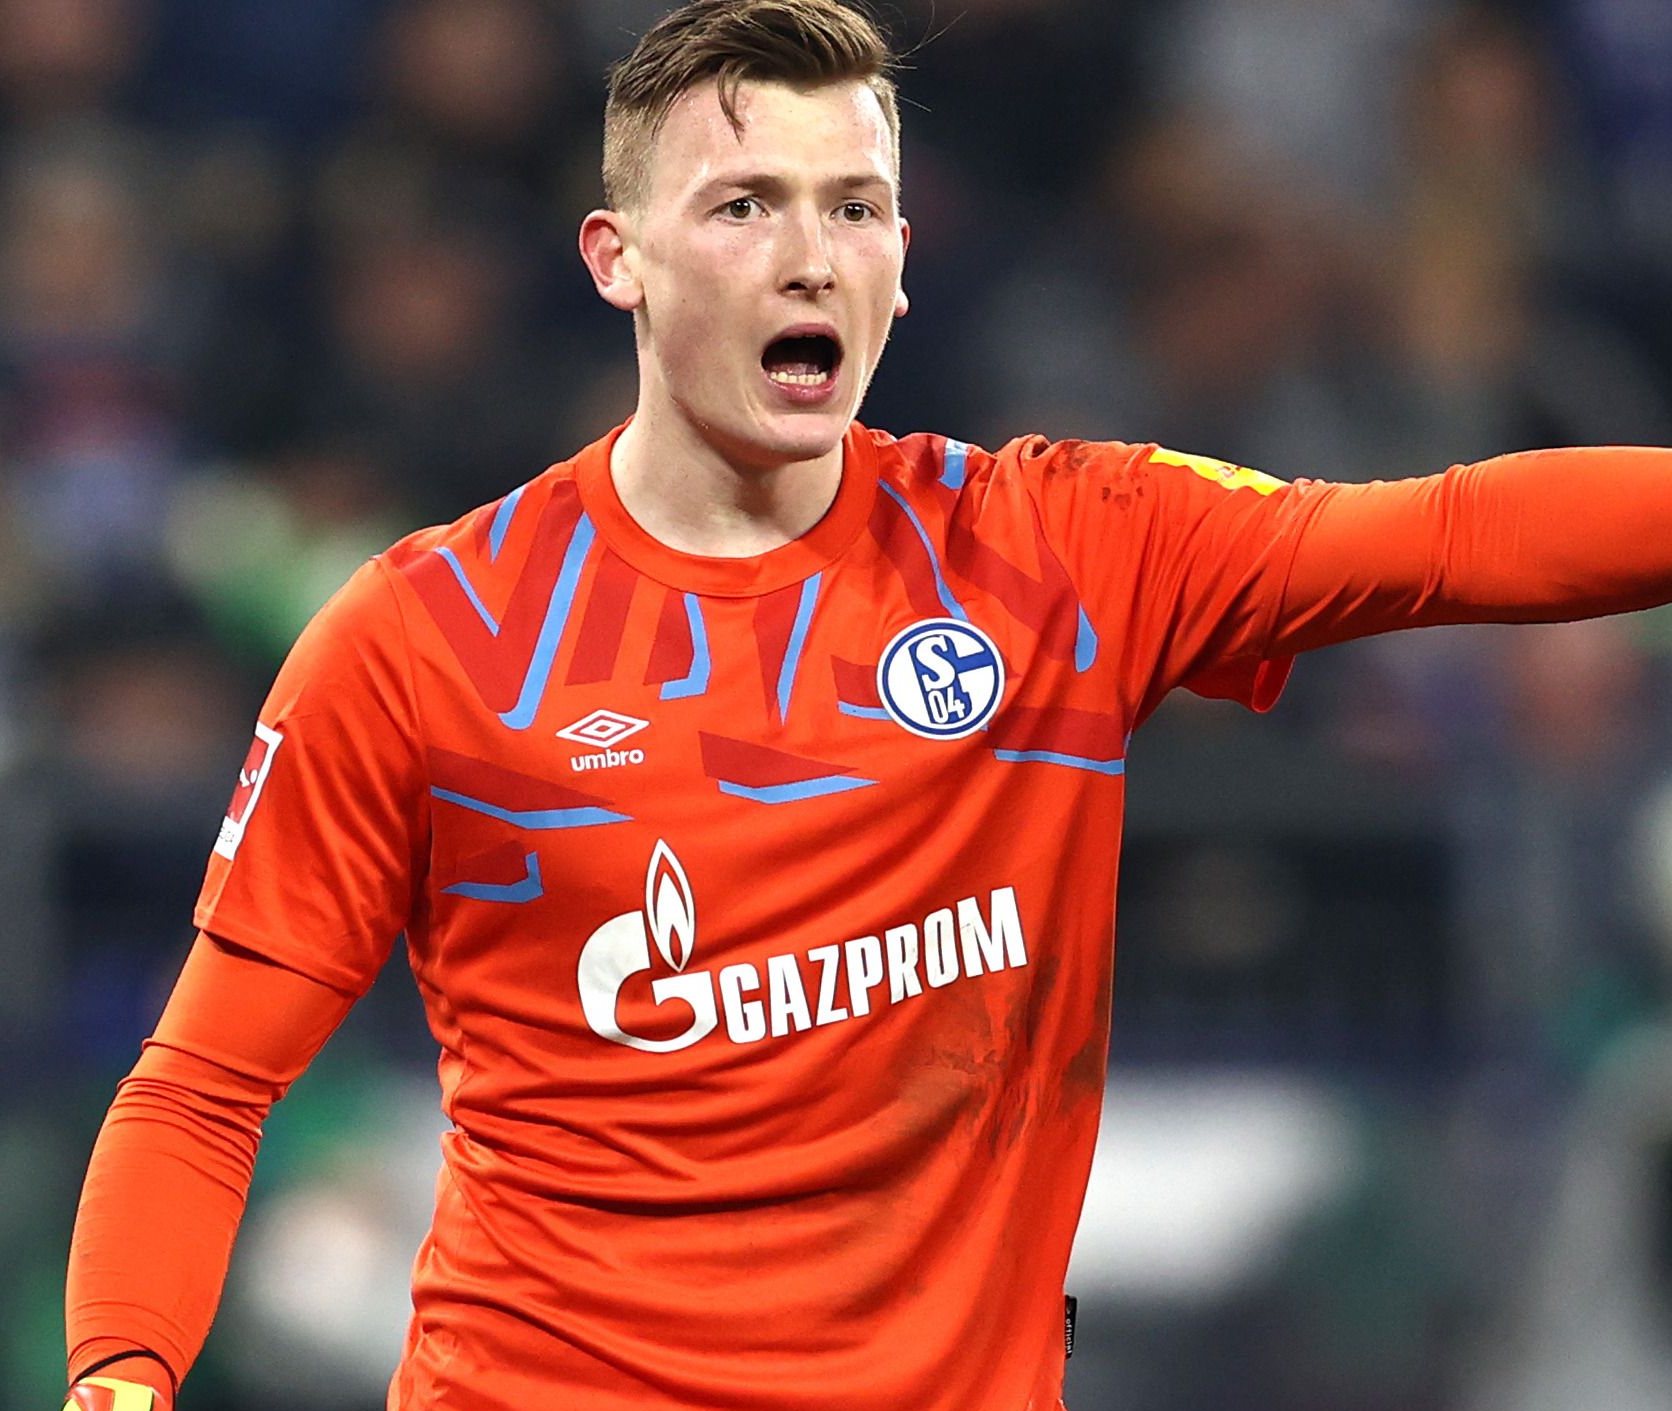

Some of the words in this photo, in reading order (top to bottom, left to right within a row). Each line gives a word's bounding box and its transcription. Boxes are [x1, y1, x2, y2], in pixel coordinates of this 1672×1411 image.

[927, 686, 965, 725] 04
[570, 748, 645, 772] umbro
[718, 885, 1029, 1046] GAZPROM
